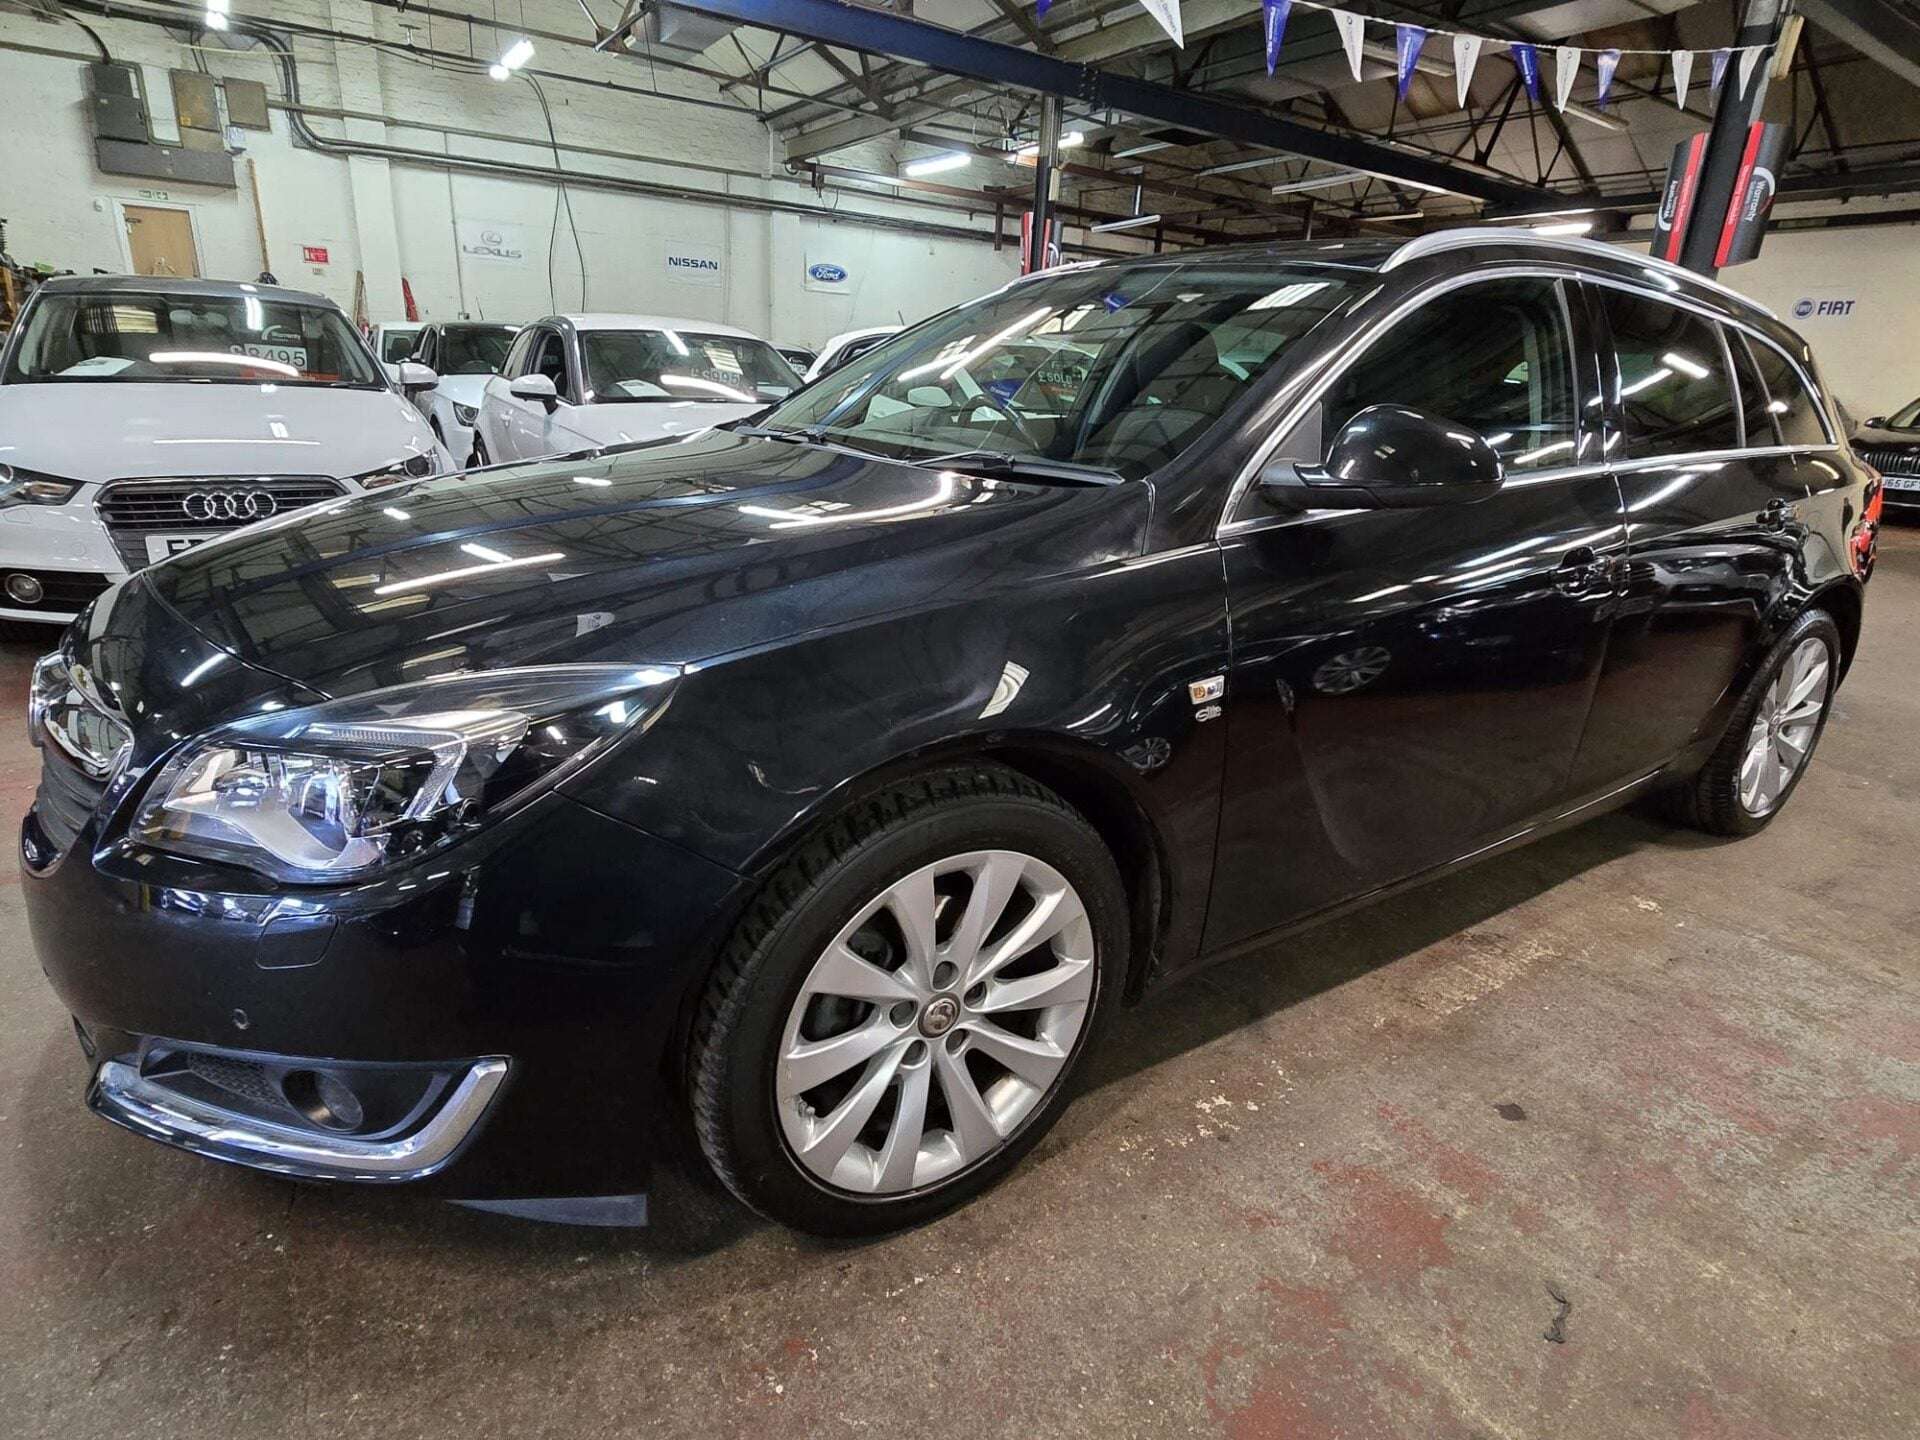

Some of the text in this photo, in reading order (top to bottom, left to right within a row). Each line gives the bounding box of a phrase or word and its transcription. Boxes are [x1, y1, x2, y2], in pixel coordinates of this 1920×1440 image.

[1744, 180, 1767, 221] Warranty
[668, 256, 719, 271] NISSAN
[815, 267, 841, 280] Ford
[1817, 300, 1855, 315] FIAT
